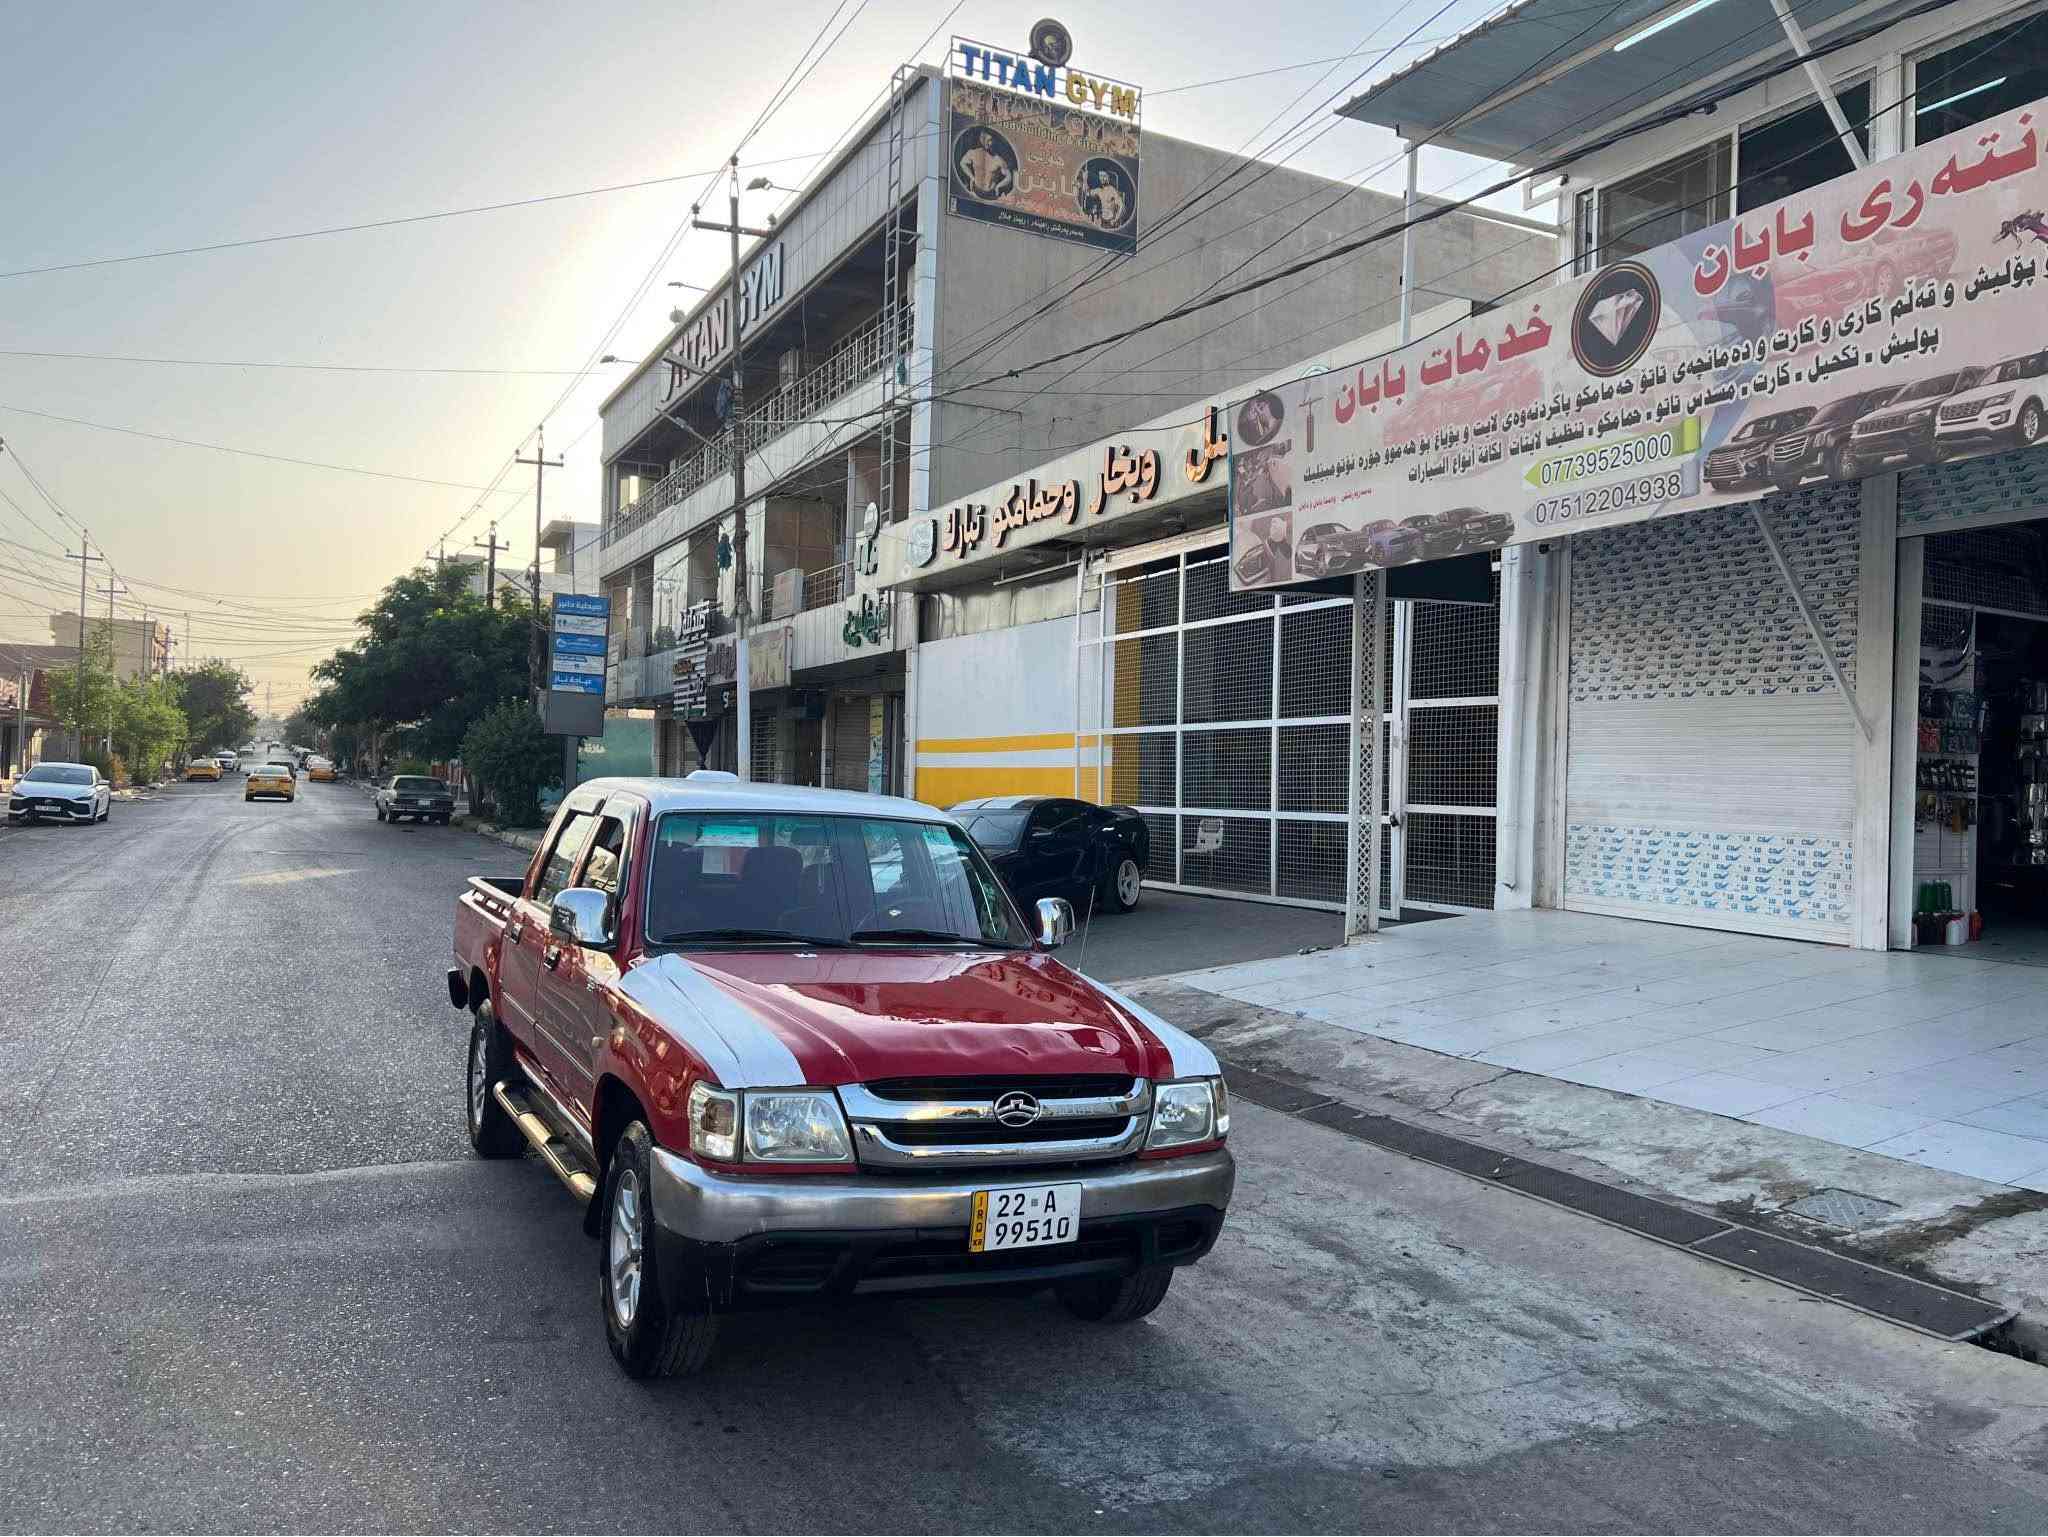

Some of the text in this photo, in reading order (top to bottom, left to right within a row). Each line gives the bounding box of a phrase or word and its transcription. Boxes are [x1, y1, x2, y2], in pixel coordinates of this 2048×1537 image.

[959, 43, 1137, 118] TITAN GYM
[1694, 206, 1815, 295] بابان
[1944, 282, 1955, 308] و
[1821, 319, 1831, 343] و
[1335, 303, 1552, 424] خدمات بابان
[1541, 433, 1672, 485] 07739525000
[1536, 474, 1681, 524] 07512204938
[997, 1190, 1056, 1218] 22 A
[995, 1216, 1070, 1245] 99510
